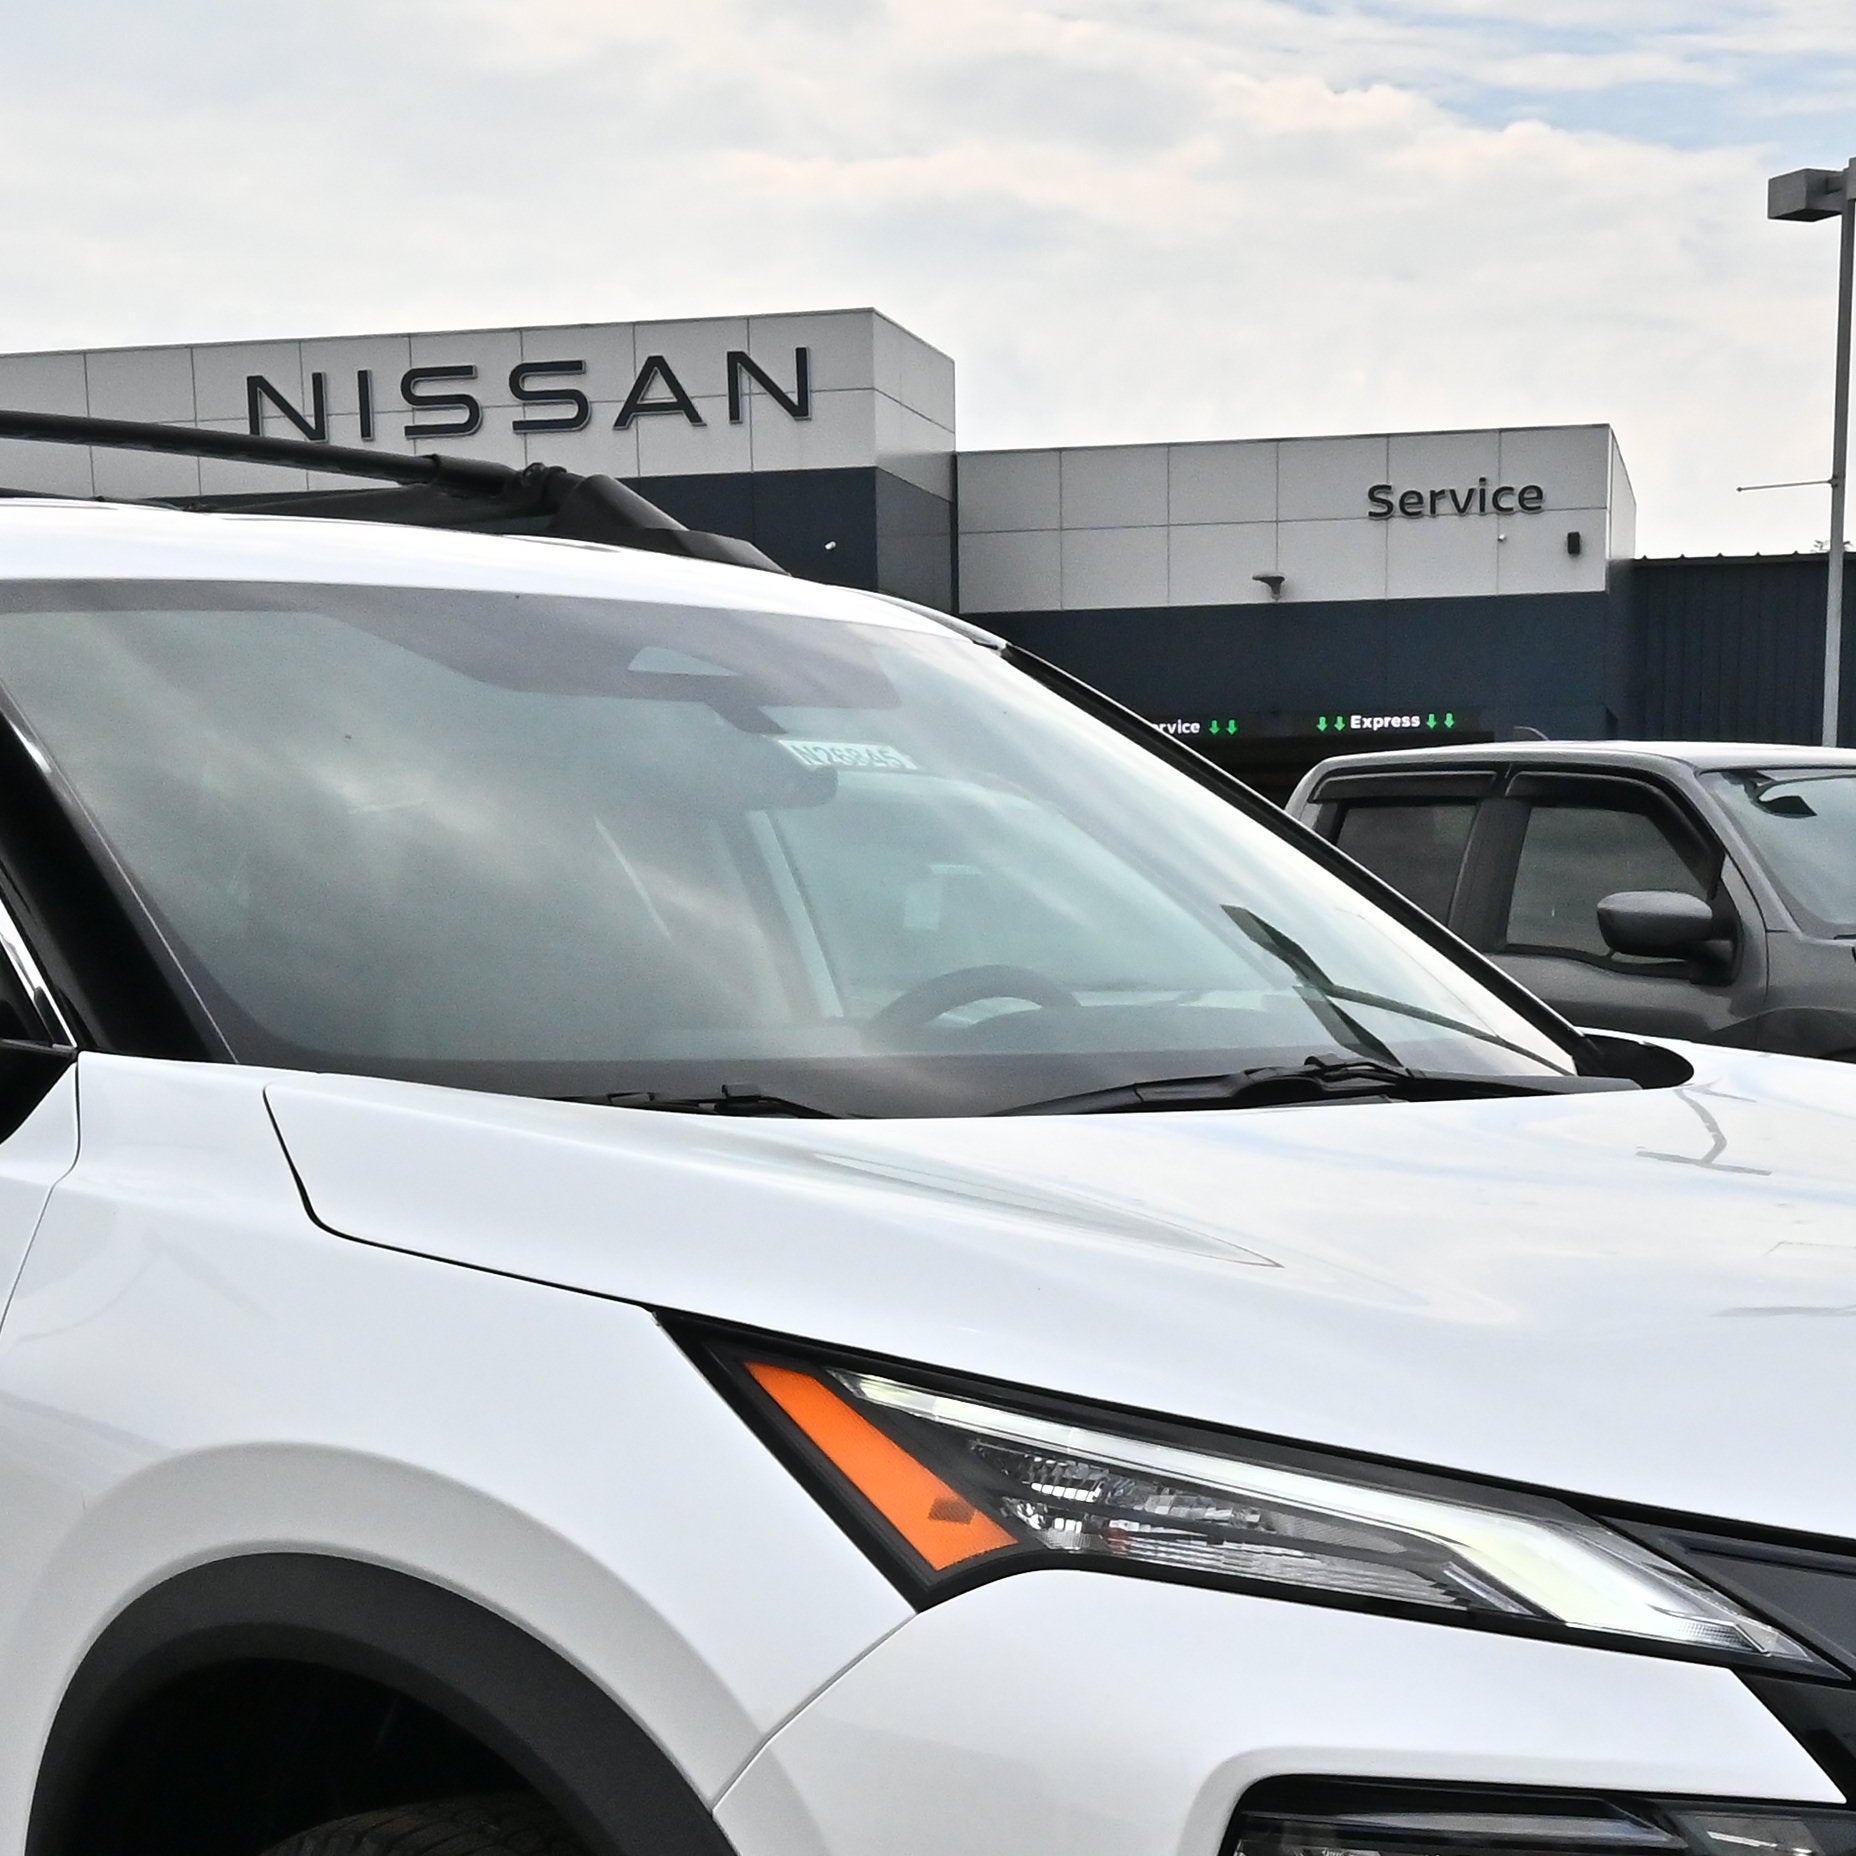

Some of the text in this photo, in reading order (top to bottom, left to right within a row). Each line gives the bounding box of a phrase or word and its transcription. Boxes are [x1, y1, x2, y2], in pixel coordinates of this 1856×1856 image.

[246, 346, 812, 443] NISSAN
[1367, 476, 1544, 520] Service
[1152, 718, 1201, 735] rvice
[1350, 714, 1422, 732] Express
